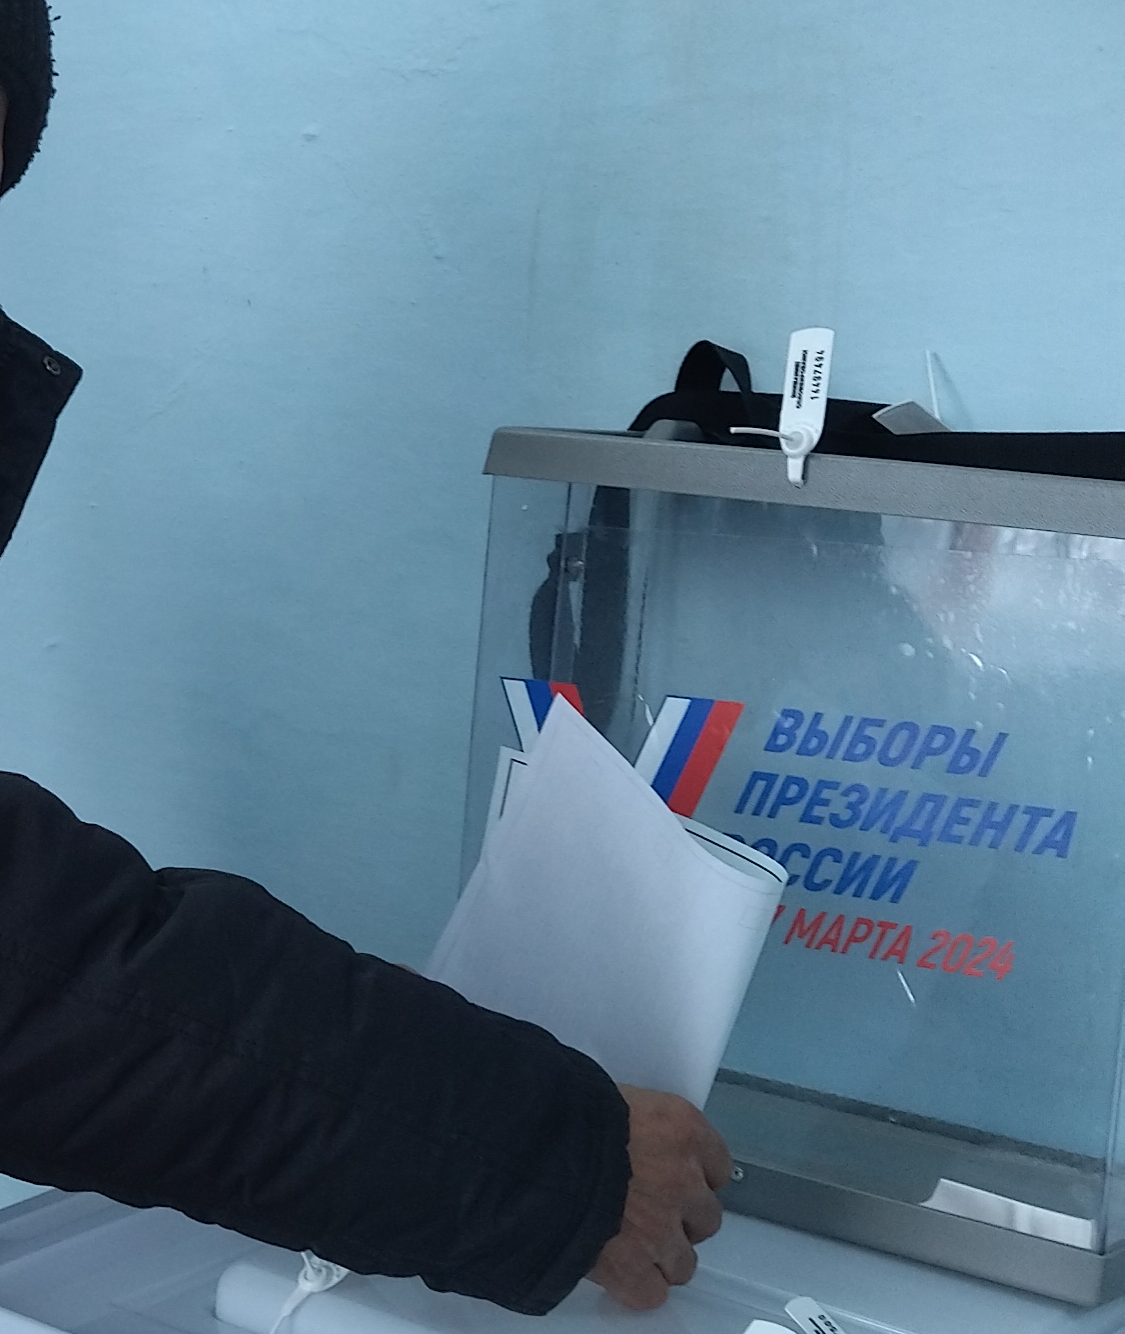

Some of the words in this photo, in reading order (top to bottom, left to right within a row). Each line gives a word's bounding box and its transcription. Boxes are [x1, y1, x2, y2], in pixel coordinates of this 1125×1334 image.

[764, 708, 1009, 778] ВЫБОРЫ
[734, 771, 1078, 858] ПРЕЗИДЕНТА
[783, 908, 914, 964] МАРТА
[916, 929, 1016, 981] 2024
